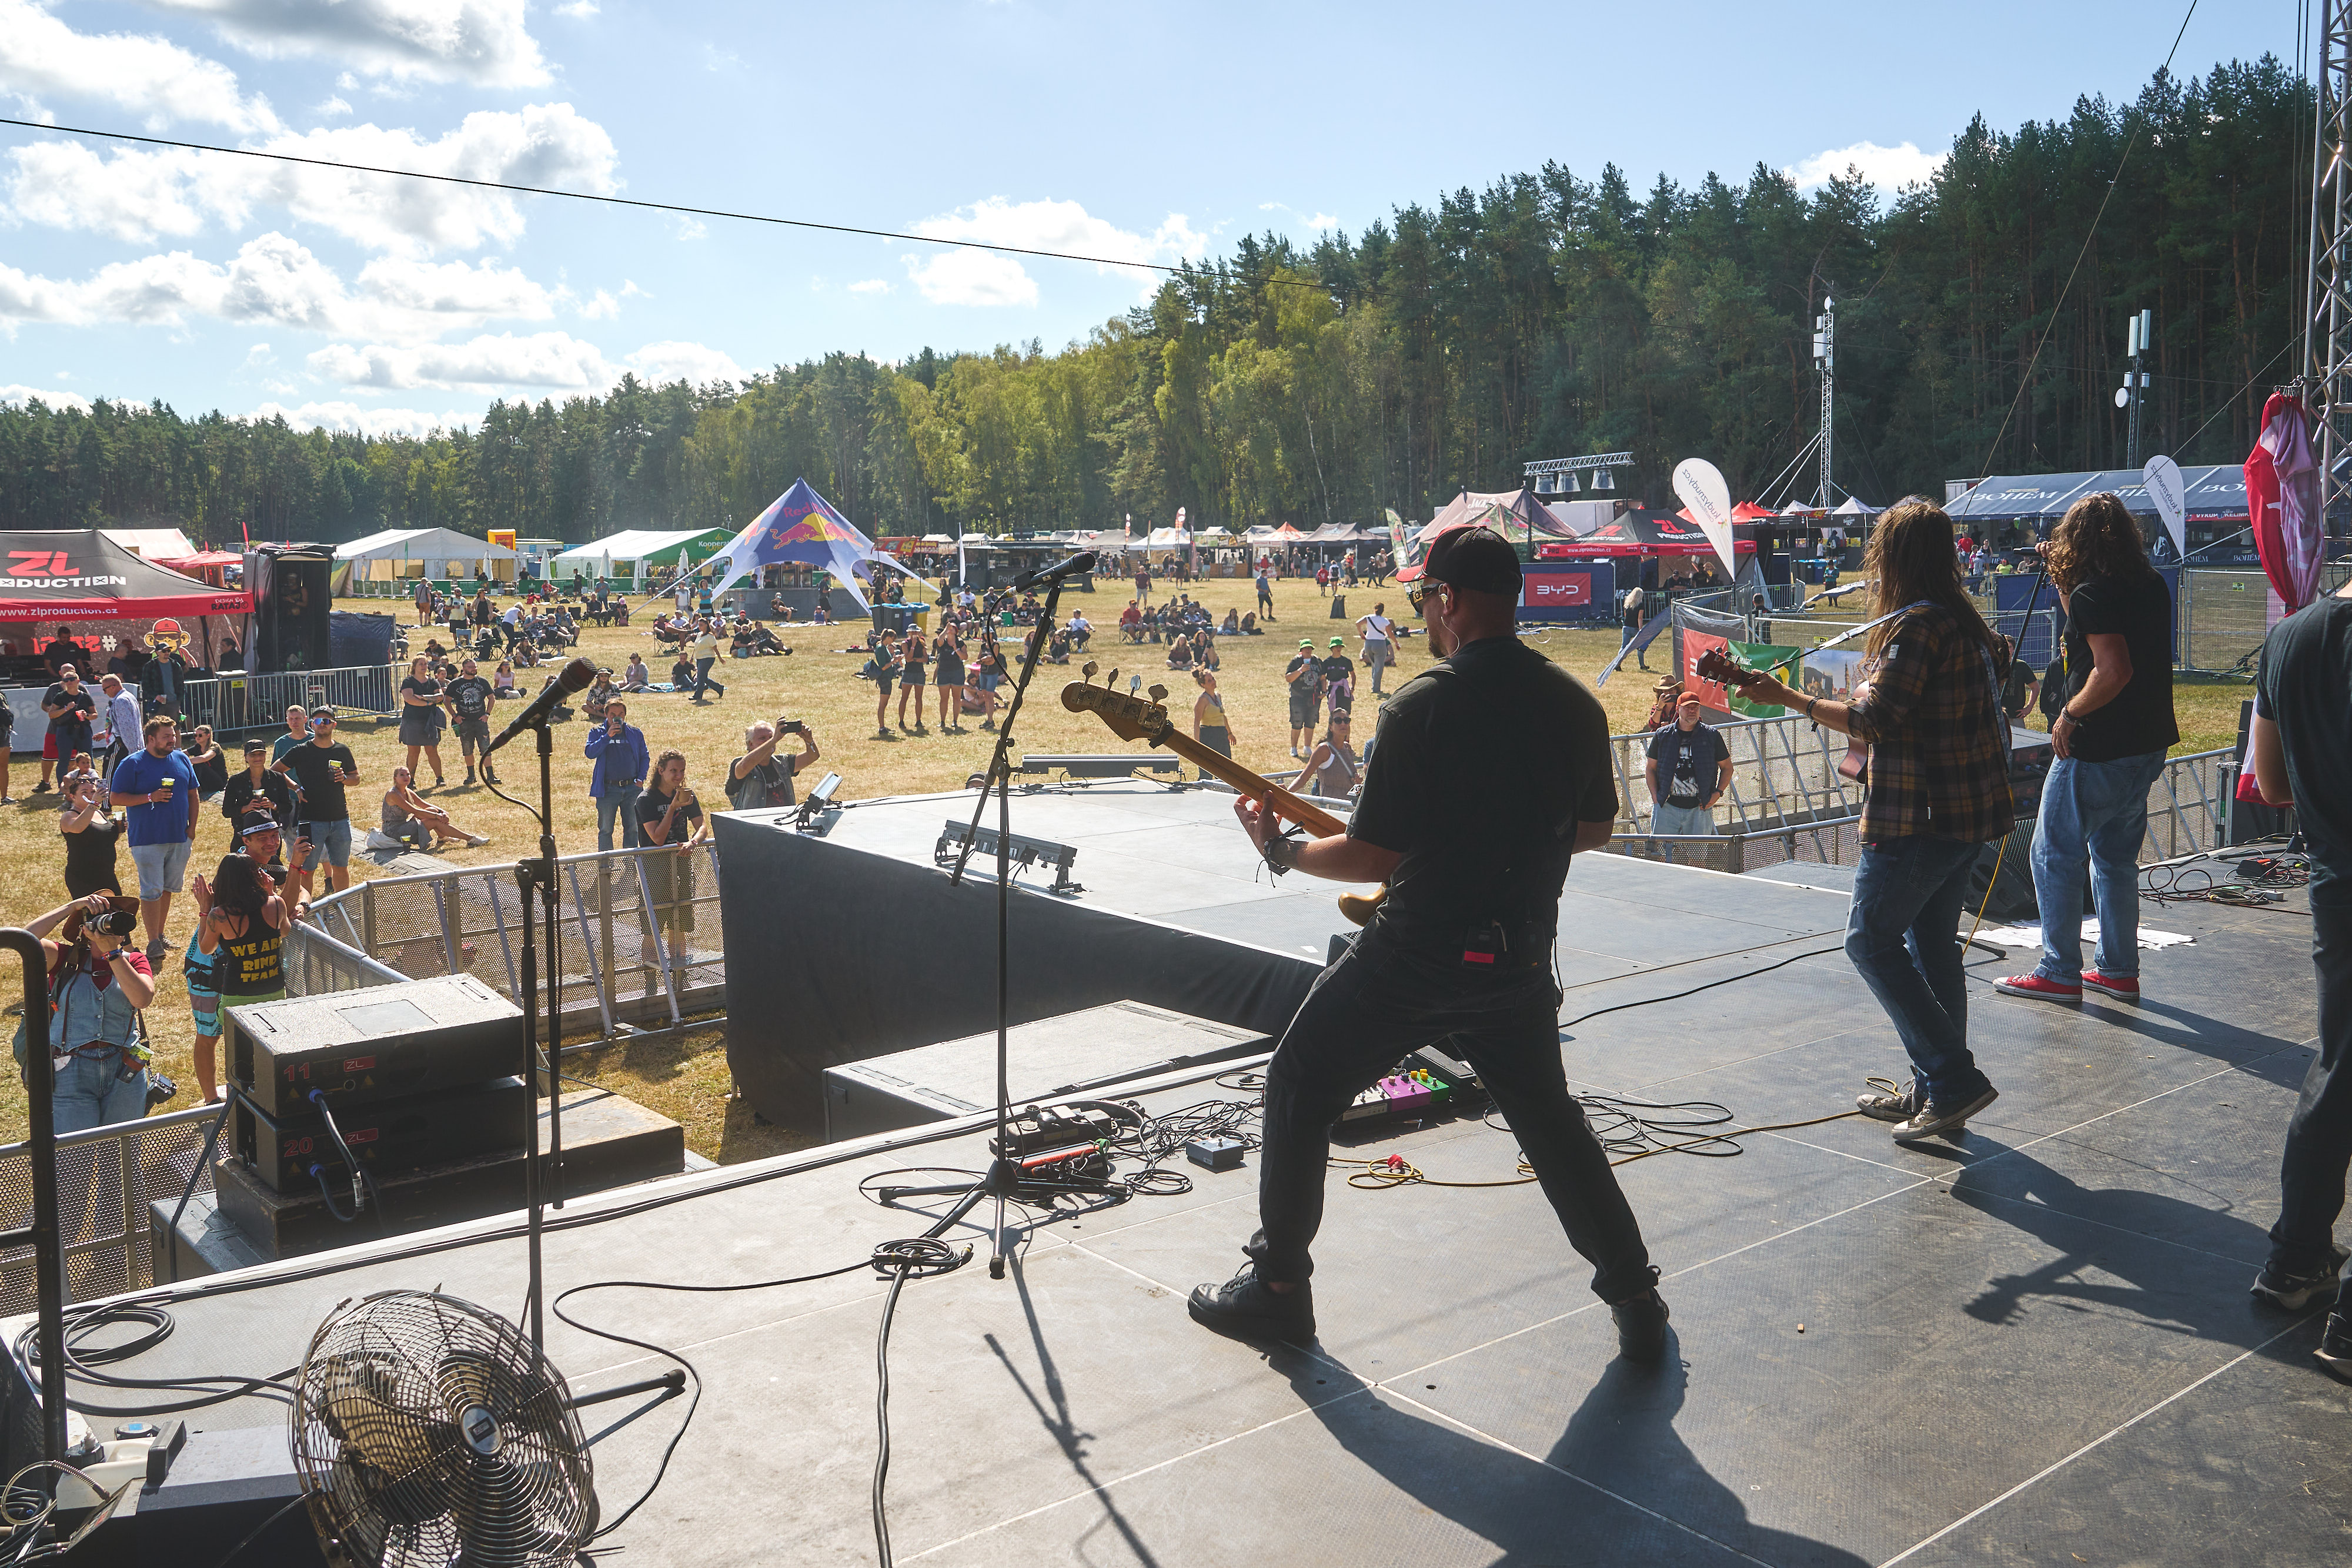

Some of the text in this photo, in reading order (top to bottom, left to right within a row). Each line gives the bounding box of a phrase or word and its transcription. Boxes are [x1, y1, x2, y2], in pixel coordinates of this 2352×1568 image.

[783, 502, 835, 518] Red Bull
[1595, 525, 1623, 536] ZL
[1652, 520, 1686, 534] ZL
[6, 550, 80, 577] ZL
[1536, 585, 1579, 595] BYD
[0, 607, 118, 617] www.zlproduction.cz
[230, 942, 257, 957] WE
[243, 954, 277, 971] RIND
[240, 966, 279, 982] TEAM
[283, 1059, 365, 1082] 11 ZL
[283, 1133, 365, 1158] 20 ZL
